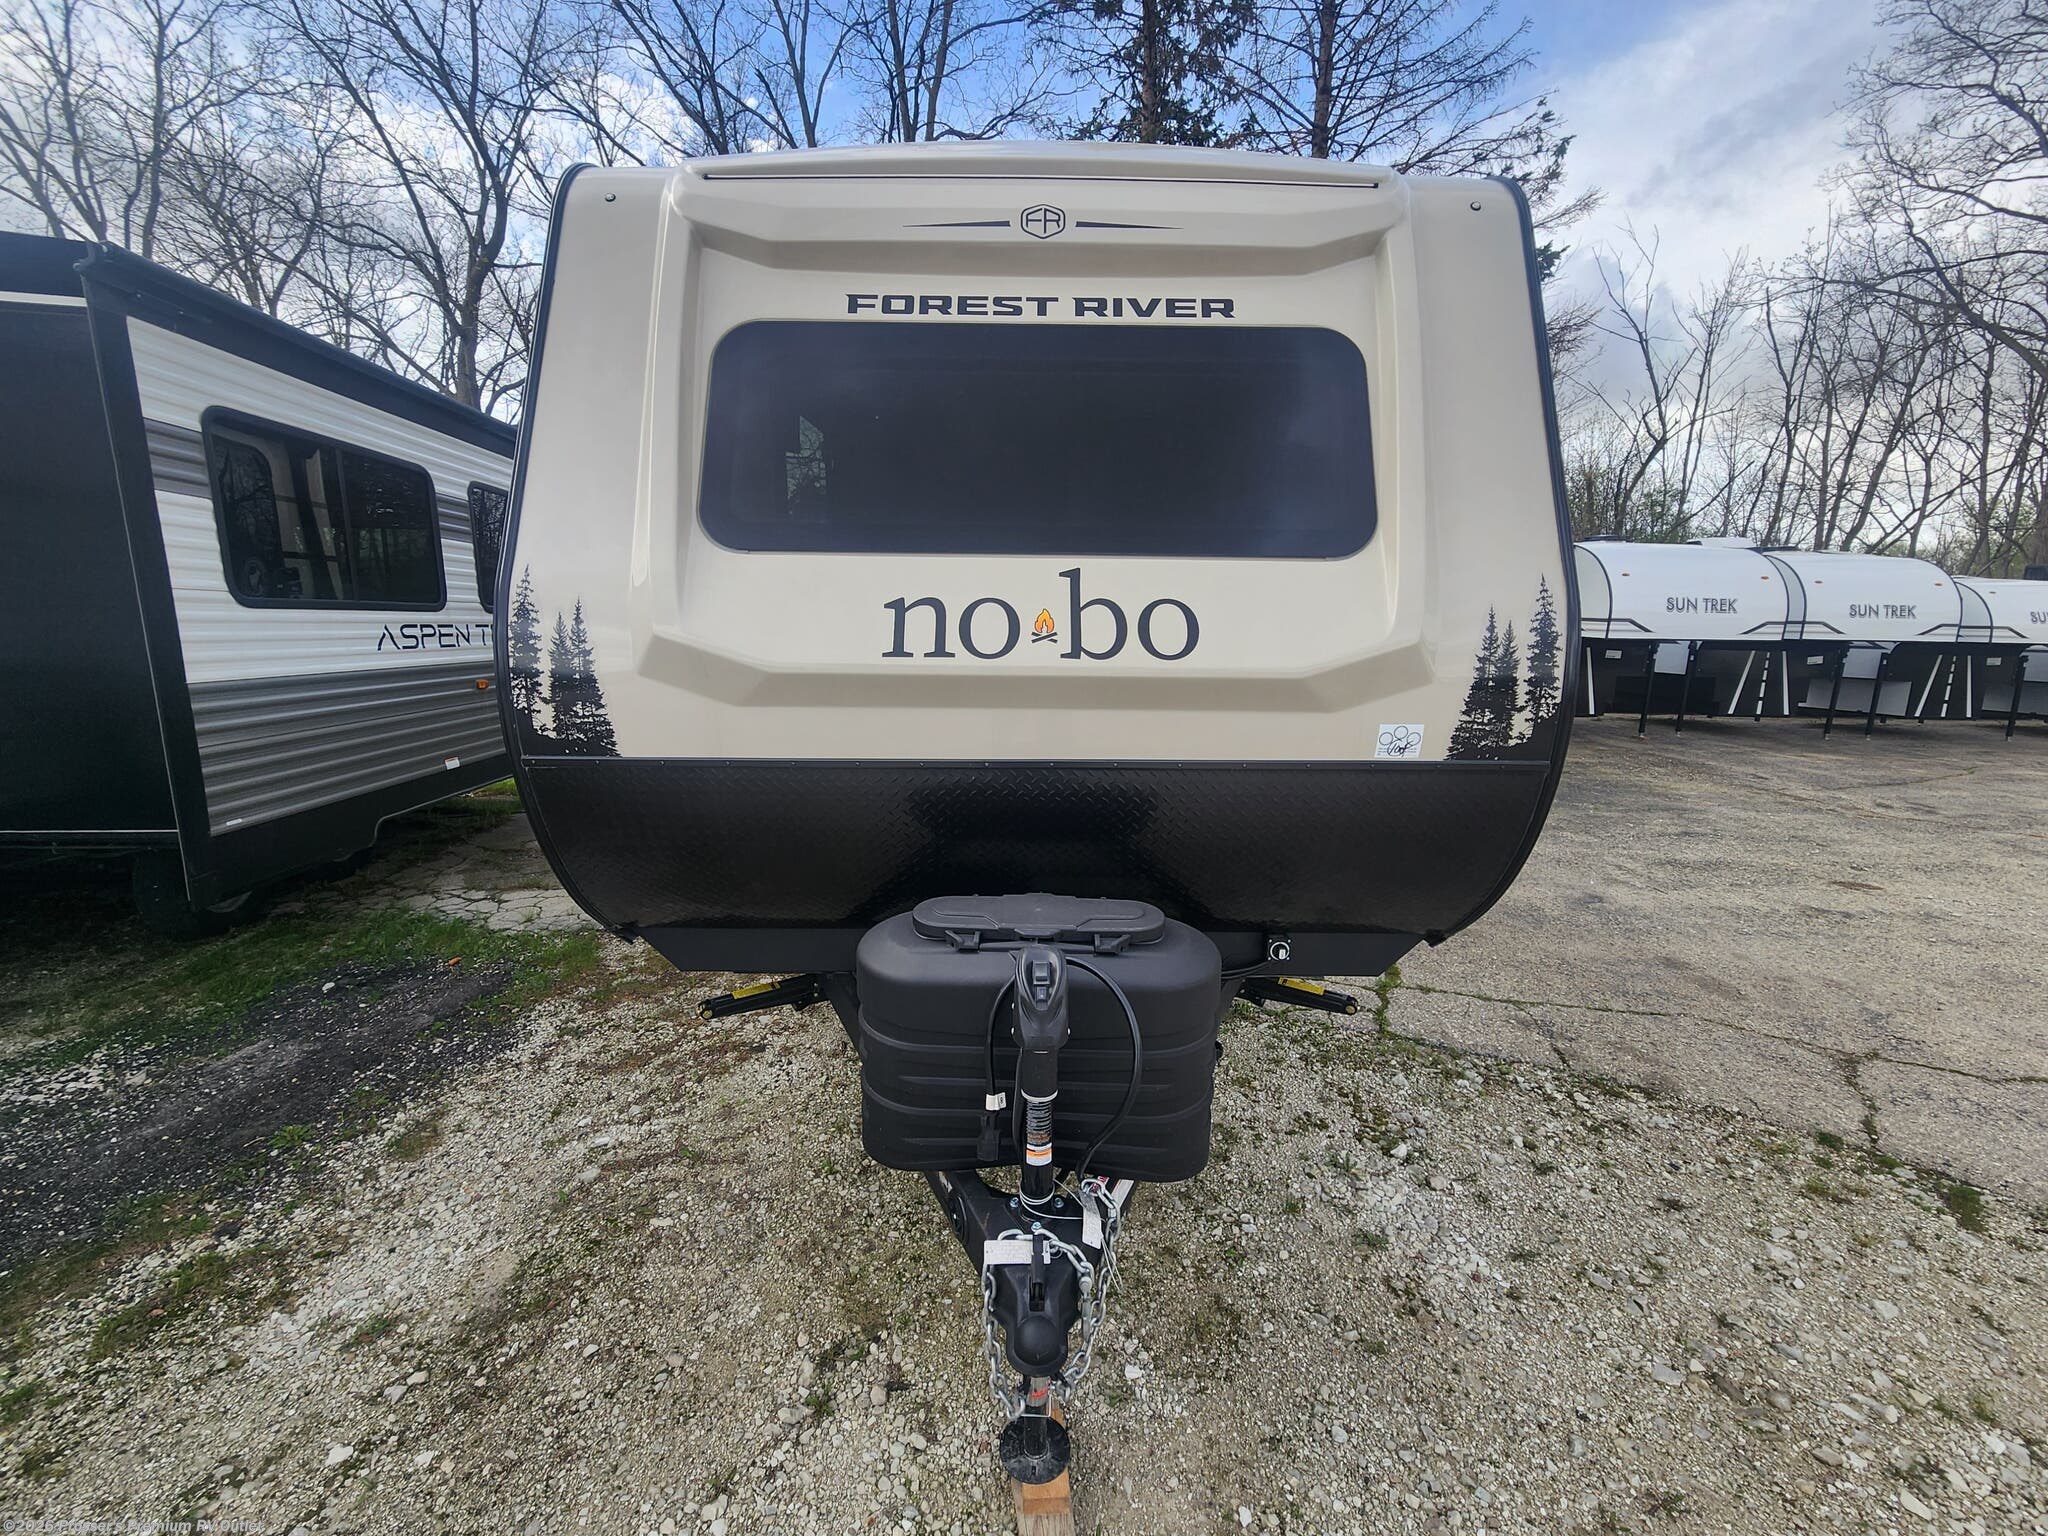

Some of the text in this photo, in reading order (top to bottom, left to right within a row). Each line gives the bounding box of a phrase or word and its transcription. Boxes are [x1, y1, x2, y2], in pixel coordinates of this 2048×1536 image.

[845, 294, 1236, 319] FOREST RIVER
[1666, 597, 1738, 613] SUN TREK
[1849, 603, 1916, 618] SUN TREK
[2030, 611, 2048, 624] SU
[377, 624, 471, 651] ASPEN
